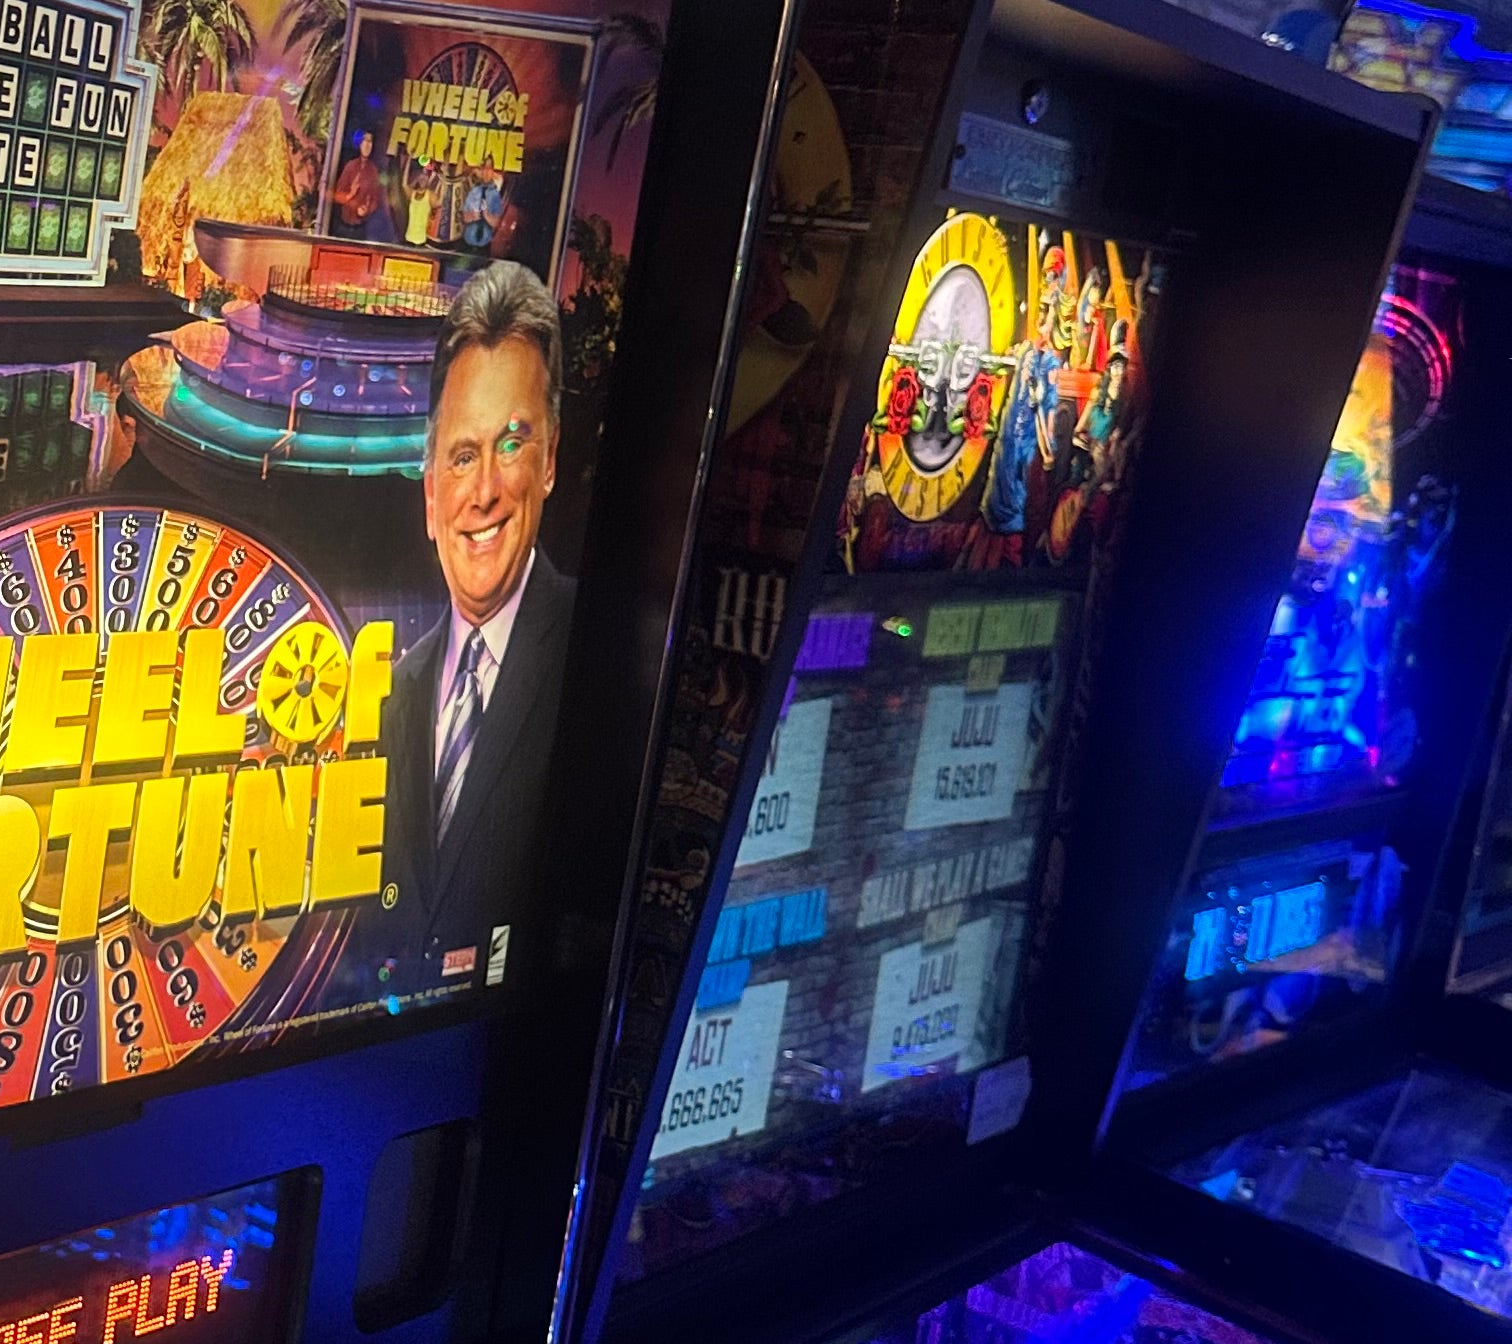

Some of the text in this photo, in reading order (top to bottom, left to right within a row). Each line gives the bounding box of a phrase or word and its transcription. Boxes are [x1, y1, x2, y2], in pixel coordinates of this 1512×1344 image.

[55, 87, 130, 133] FUN
[402, 78, 495, 123] WHEEL
[386, 116, 527, 173] FORTUNE
[104, 513, 141, 633] $300
[103, 934, 144, 1075] $300
[155, 938, 207, 1030] $60
[49, 951, 90, 1096] $500
[685, 1017, 734, 1073] ACT
[660, 1077, 745, 1135] .666.665
